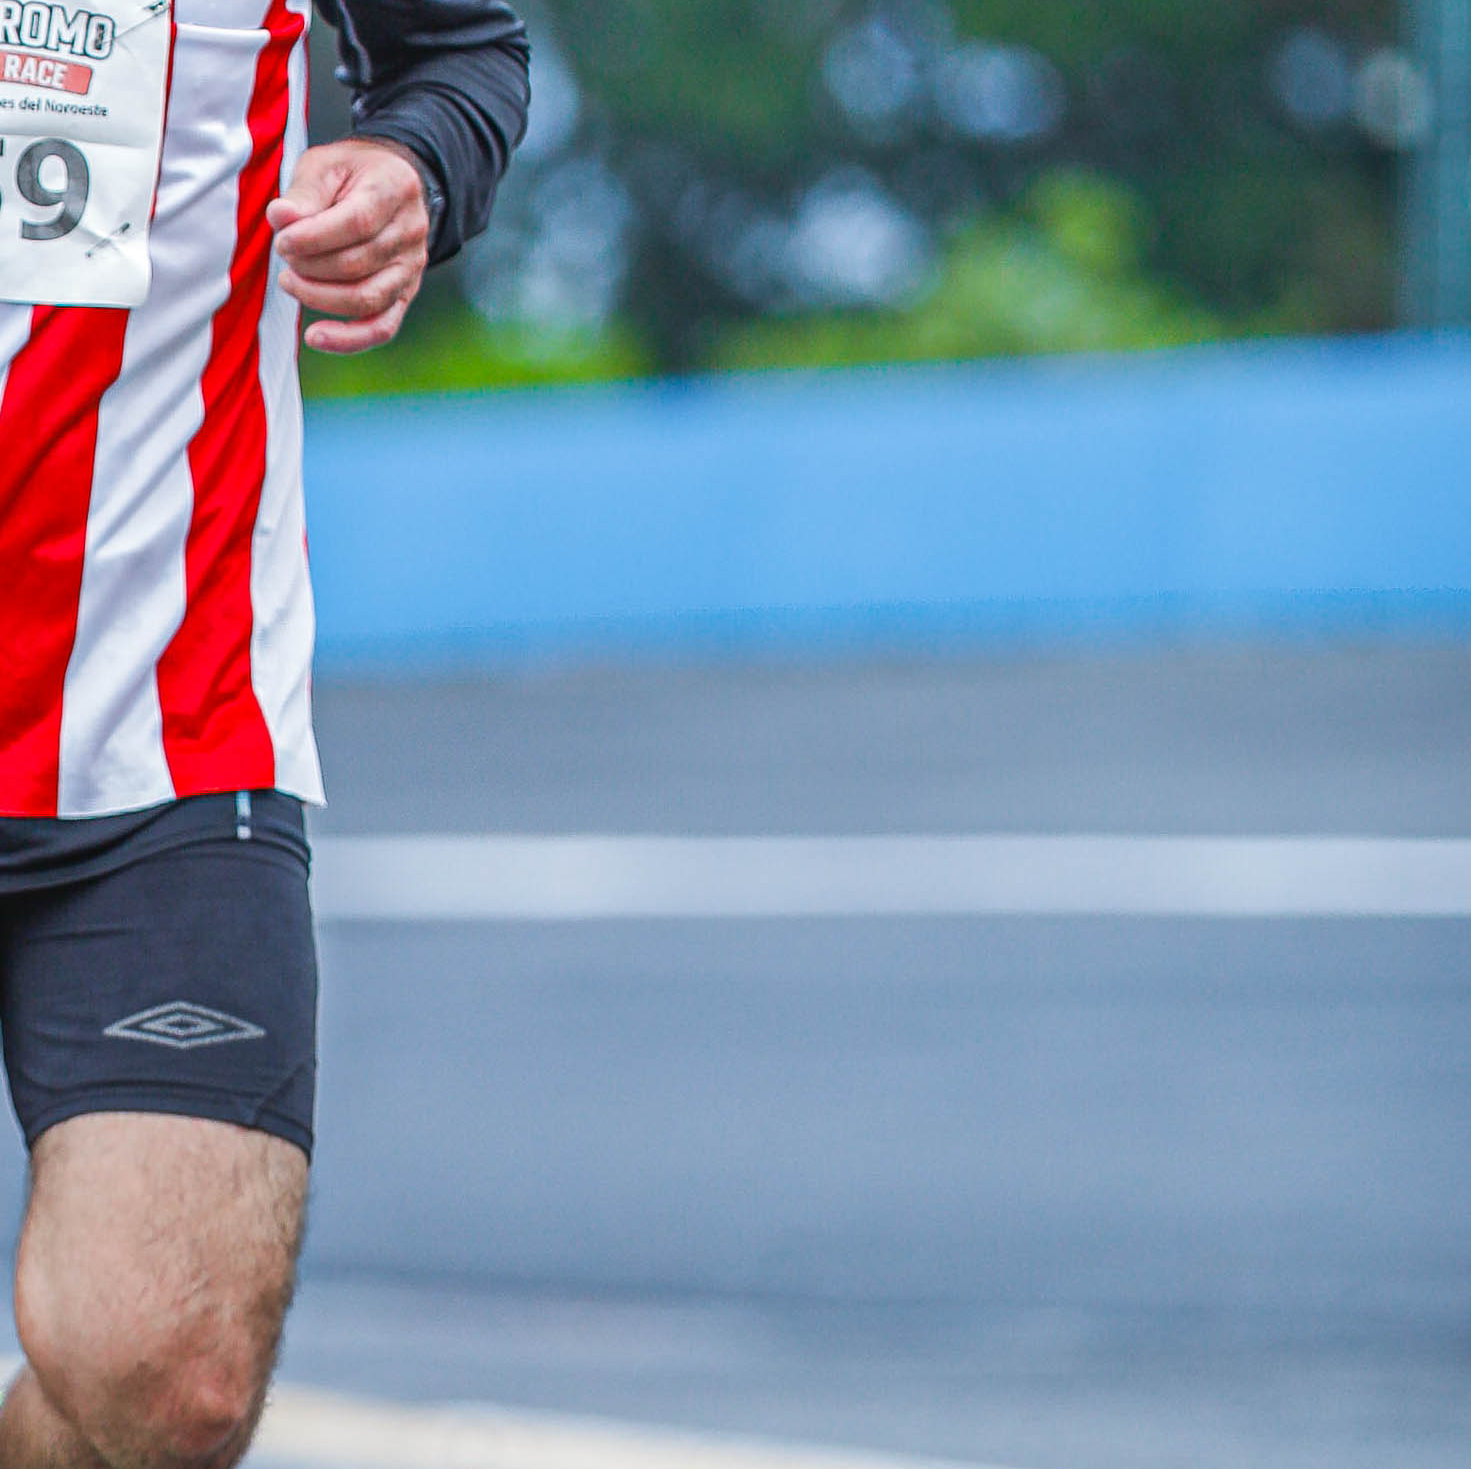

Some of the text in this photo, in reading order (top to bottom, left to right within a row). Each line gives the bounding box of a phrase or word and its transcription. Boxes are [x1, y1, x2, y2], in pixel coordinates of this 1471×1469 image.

[5, 53, 68, 88] RACE
[18, 96, 41, 112] del
[44, 98, 108, 117] Noroeste
